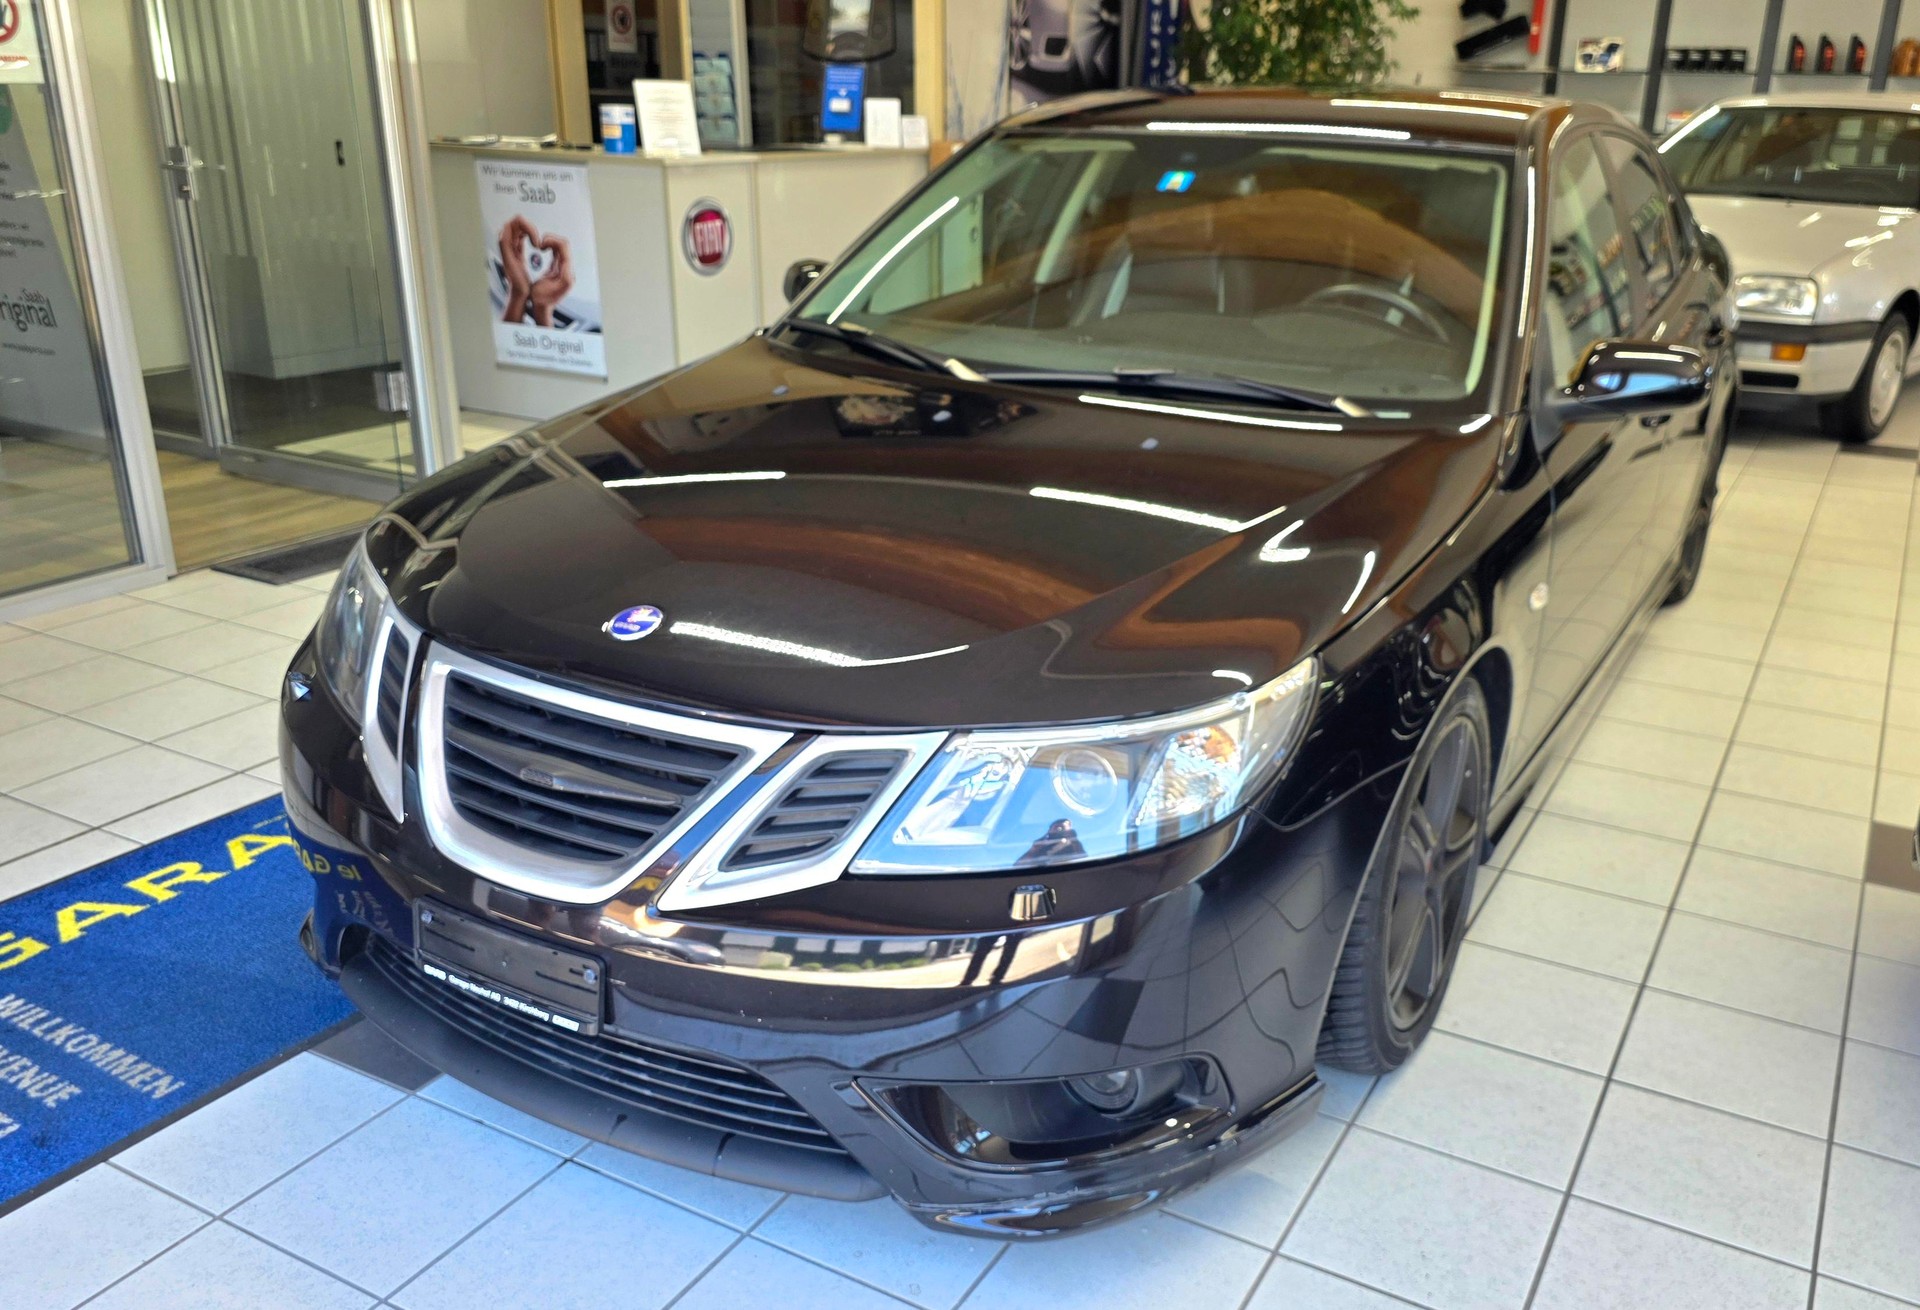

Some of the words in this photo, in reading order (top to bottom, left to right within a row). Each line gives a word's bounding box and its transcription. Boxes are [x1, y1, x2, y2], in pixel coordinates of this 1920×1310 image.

[519, 180, 556, 204] Saab
[694, 219, 725, 256] FIAT
[0, 293, 58, 333] riginal
[513, 331, 538, 349] Saab
[541, 335, 585, 355] Original
[0, 833, 294, 971] GARA
[0, 993, 186, 1099] WILLKOMMEN
